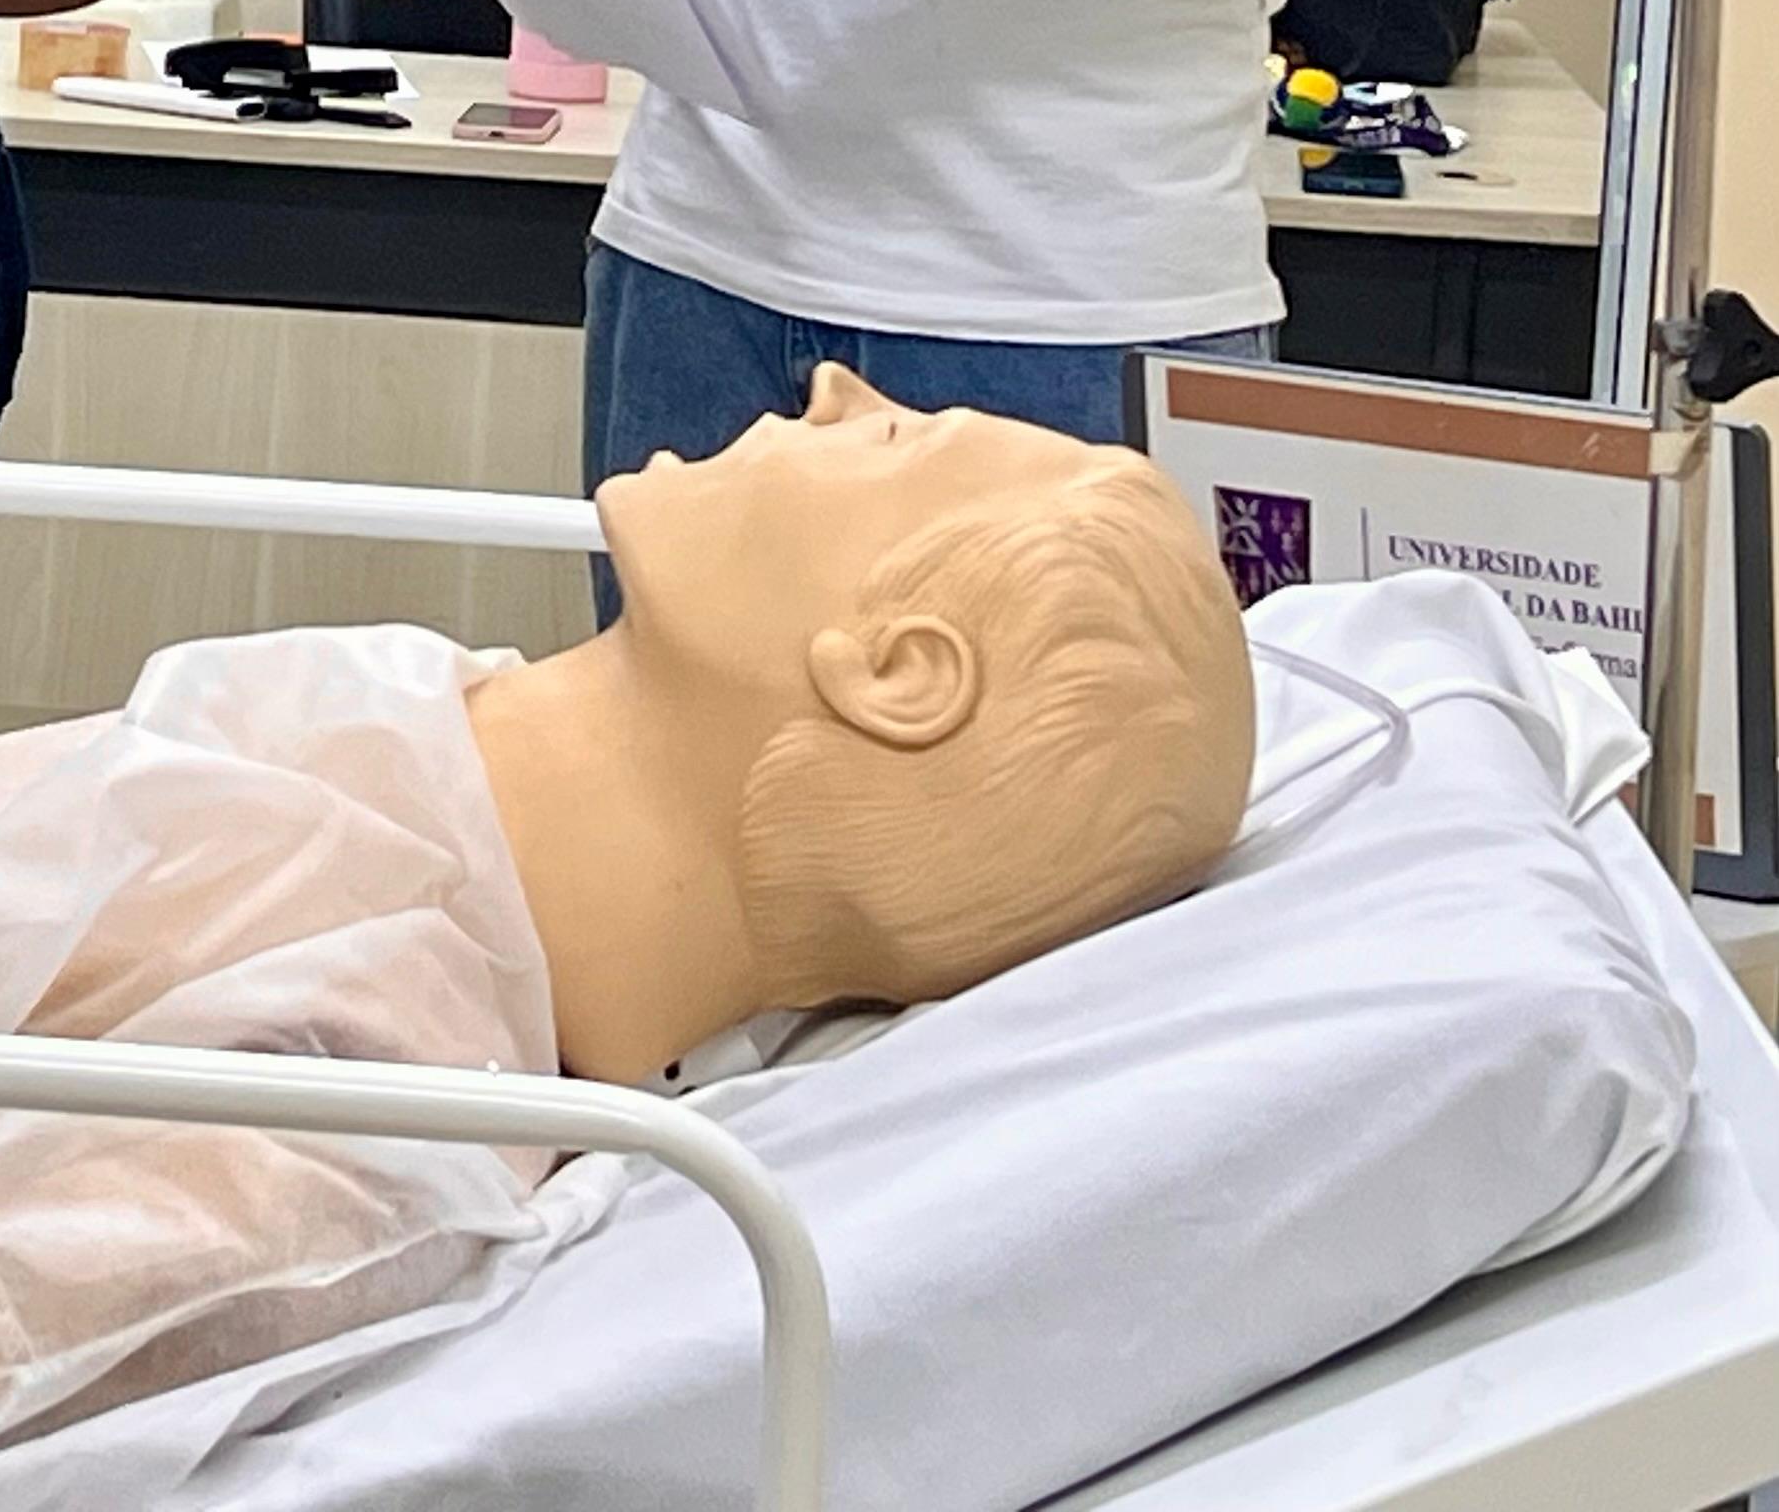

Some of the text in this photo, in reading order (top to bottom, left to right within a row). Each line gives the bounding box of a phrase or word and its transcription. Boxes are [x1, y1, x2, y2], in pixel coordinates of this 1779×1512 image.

[1388, 535, 1602, 589] UNIVERSIDADE
[1525, 593, 1565, 623] DA
[1572, 599, 1643, 635] BAHI
